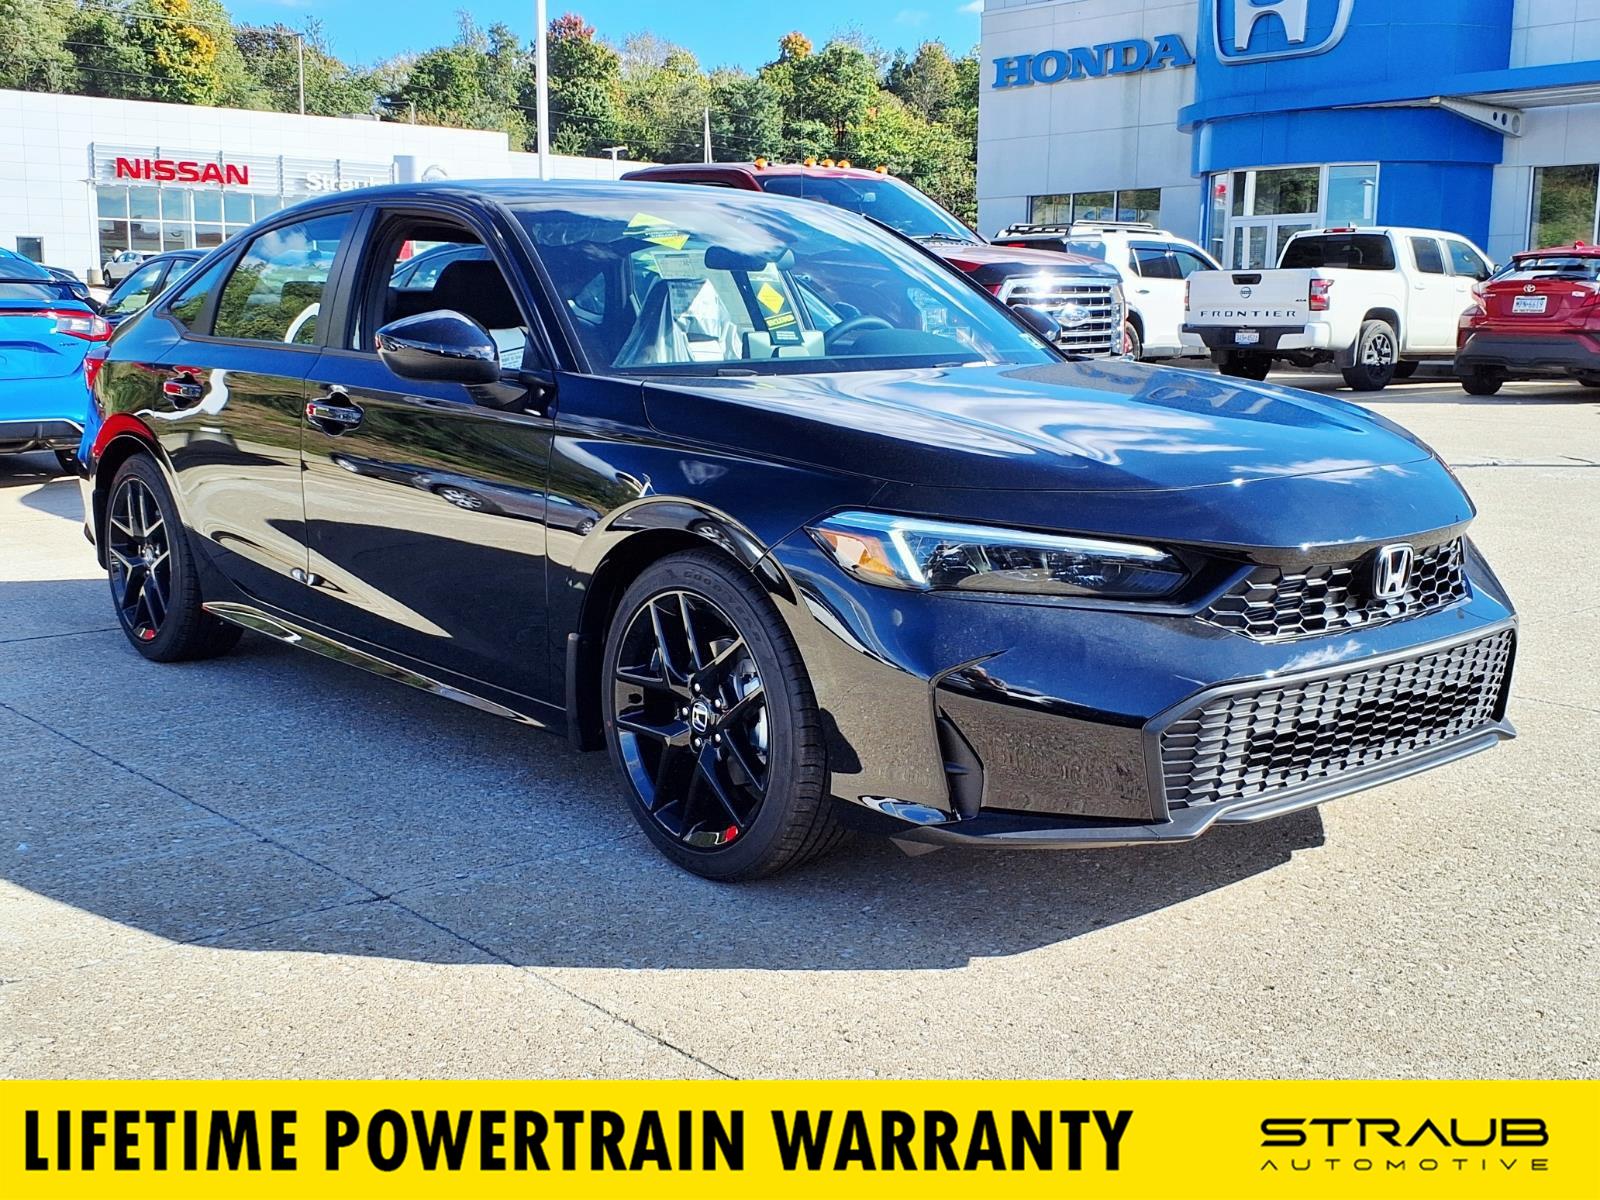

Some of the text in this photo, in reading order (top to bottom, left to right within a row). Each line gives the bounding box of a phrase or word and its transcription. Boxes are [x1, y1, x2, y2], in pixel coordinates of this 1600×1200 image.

[992, 34, 1196, 89] HONDA
[115, 157, 250, 185] NISSAN
[1200, 310, 1296, 318] FRONTIER
